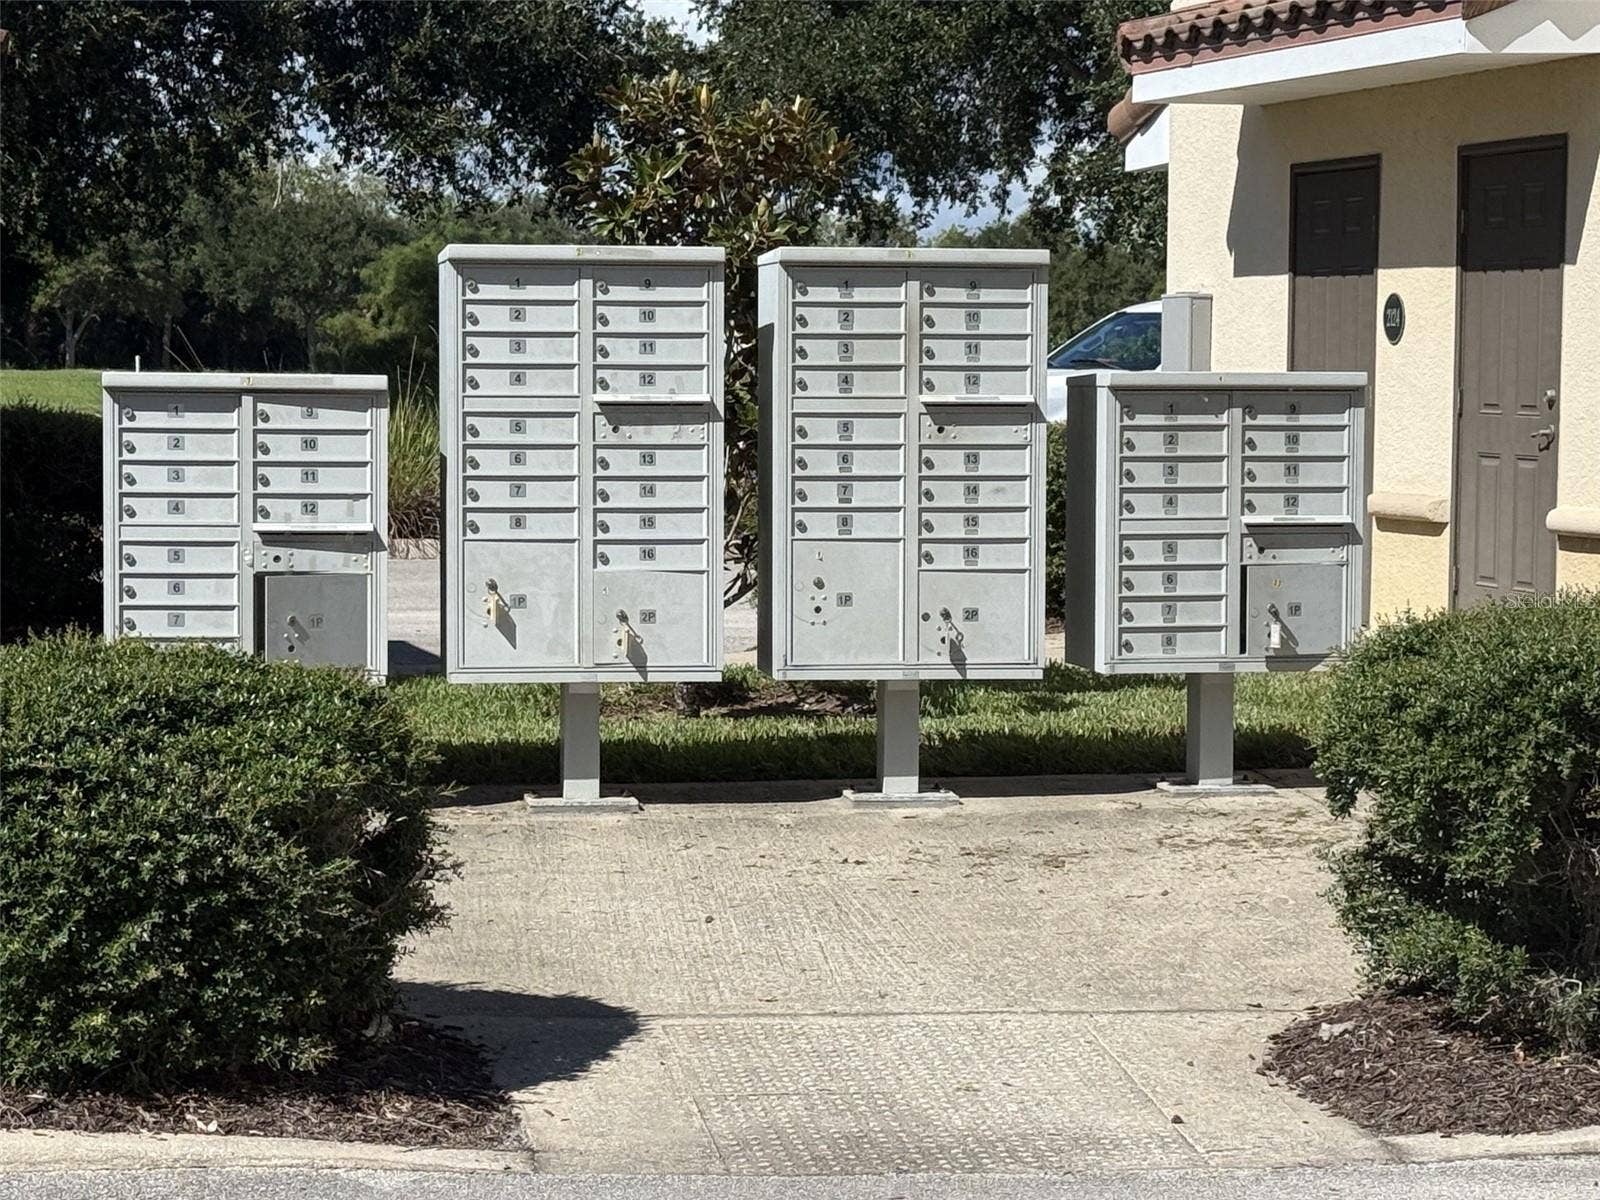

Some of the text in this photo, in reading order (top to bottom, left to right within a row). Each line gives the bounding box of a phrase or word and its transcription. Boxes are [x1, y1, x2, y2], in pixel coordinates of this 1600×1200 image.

[515, 278, 520, 288] 1
[644, 278, 651, 289] 9
[843, 280, 848, 290] 1
[969, 281, 976, 290] 9
[514, 309, 521, 320] 2
[641, 310, 654, 321] 10
[843, 312, 850, 322] 2
[966, 312, 979, 322] 10
[514, 341, 522, 352] 3
[642, 342, 654, 352] 11
[842, 343, 850, 354] 3
[966, 344, 978, 354] 11
[514, 373, 522, 383] 4
[640, 374, 654, 385] 12
[842, 375, 849, 385] 4
[966, 375, 979, 386] 12
[173, 405, 179, 416] 1
[305, 406, 313, 417] 9
[1169, 404, 1174, 414] 1
[1289, 403, 1296, 414] 9
[514, 422, 522, 432] 5
[842, 422, 850, 433] 5
[173, 437, 180, 448] 2
[303, 439, 316, 449] 10
[1167, 434, 1175, 445] 2
[1286, 434, 1299, 445] 10
[514, 453, 522, 464] 6
[641, 454, 654, 464] 13
[842, 454, 849, 464] 6
[966, 454, 978, 464] 13
[172, 470, 180, 481] 3
[1167, 465, 1174, 476] 3
[1286, 465, 1297, 476] 11
[303, 471, 316, 481] 11
[514, 485, 522, 496] 7
[642, 485, 654, 495] 14
[841, 485, 849, 496] 7
[965, 486, 978, 496] 14
[1166, 496, 1174, 506] 4
[1285, 496, 1298, 507] 12
[172, 502, 180, 512] 4
[303, 503, 316, 513] 12
[514, 517, 522, 528] 8
[641, 517, 654, 527] 15
[841, 517, 848, 527] 8
[965, 516, 978, 527] 15
[965, 547, 978, 558] 16
[1167, 543, 1174, 554] 5
[173, 550, 180, 561] 5
[642, 549, 654, 559] 16
[1166, 574, 1174, 584] 6
[173, 582, 180, 593] 6
[512, 597, 525, 607] 1P
[839, 595, 852, 605] 1P
[1166, 604, 1173, 615] 7
[1289, 605, 1301, 616] 1P
[173, 614, 180, 625] 7
[642, 612, 656, 622] 2P
[964, 610, 978, 620] 2P
[1165, 636, 1173, 646] 8
